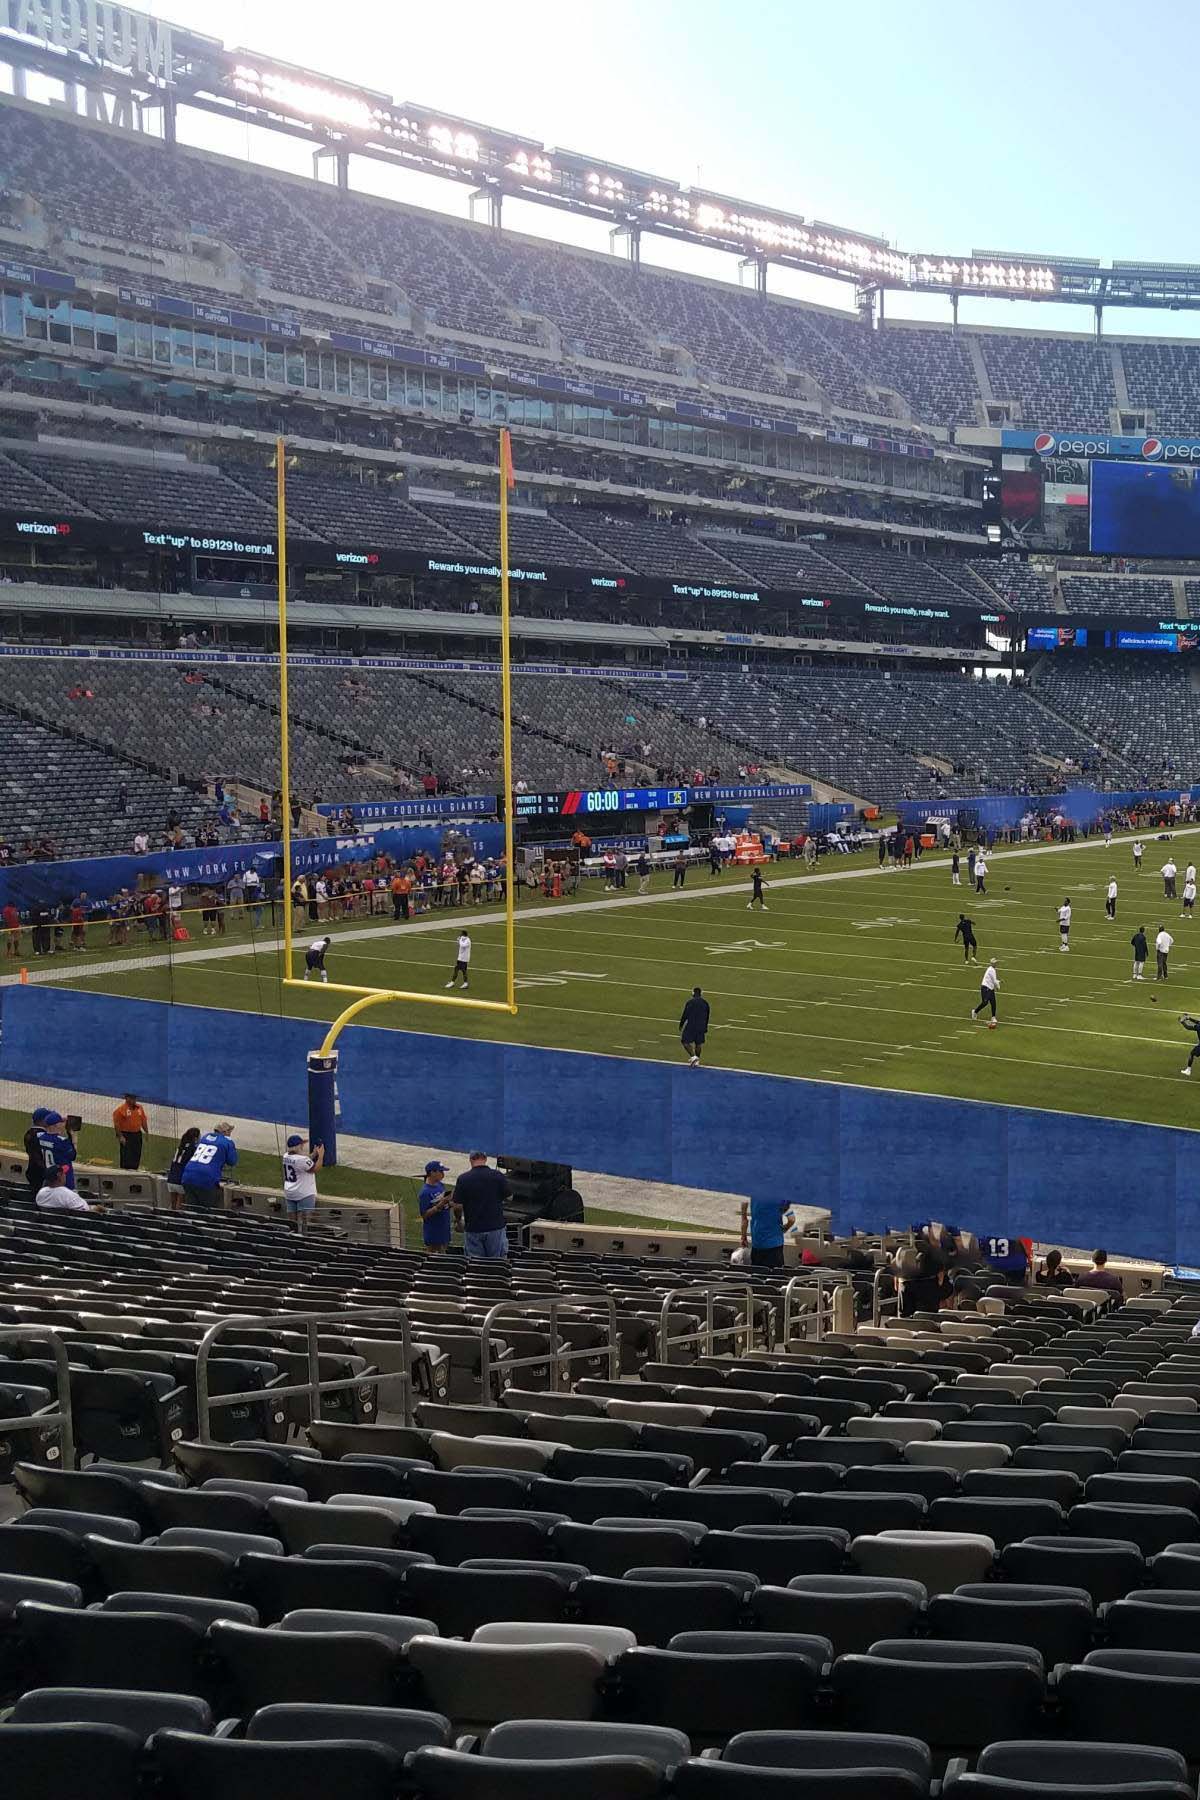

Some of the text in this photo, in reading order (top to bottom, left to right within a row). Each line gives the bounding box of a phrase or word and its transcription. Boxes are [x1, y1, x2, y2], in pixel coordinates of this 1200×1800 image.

[1058, 440, 1110, 459] pepsi
[143, 532, 166, 545] Text
[190, 537, 201, 549] to
[202, 538, 233, 551] 89129
[234, 541, 244, 552] to
[245, 542, 275, 555] enroll.
[429, 560, 464, 573] Rewards
[464, 564, 479, 576] you
[507, 568, 526, 581] eally
[526, 570, 548, 581] want.
[673, 584, 687, 595] Text
[1159, 622, 1174, 631] Text
[516, 795, 537, 804] PATRIOTS
[587, 791, 619, 811] 60:00
[694, 787, 804, 799] NEW YORK FOOTBALL GIANTS
[360, 806, 387, 817] YORK
[394, 803, 444, 815] FOOTBALL
[450, 800, 486, 811] GIANTS
[516, 806, 537, 815] GIANTS
[198, 863, 227, 875] YORK
[284, 1163, 297, 1183] 13
[989, 1238, 1009, 1257] 13
